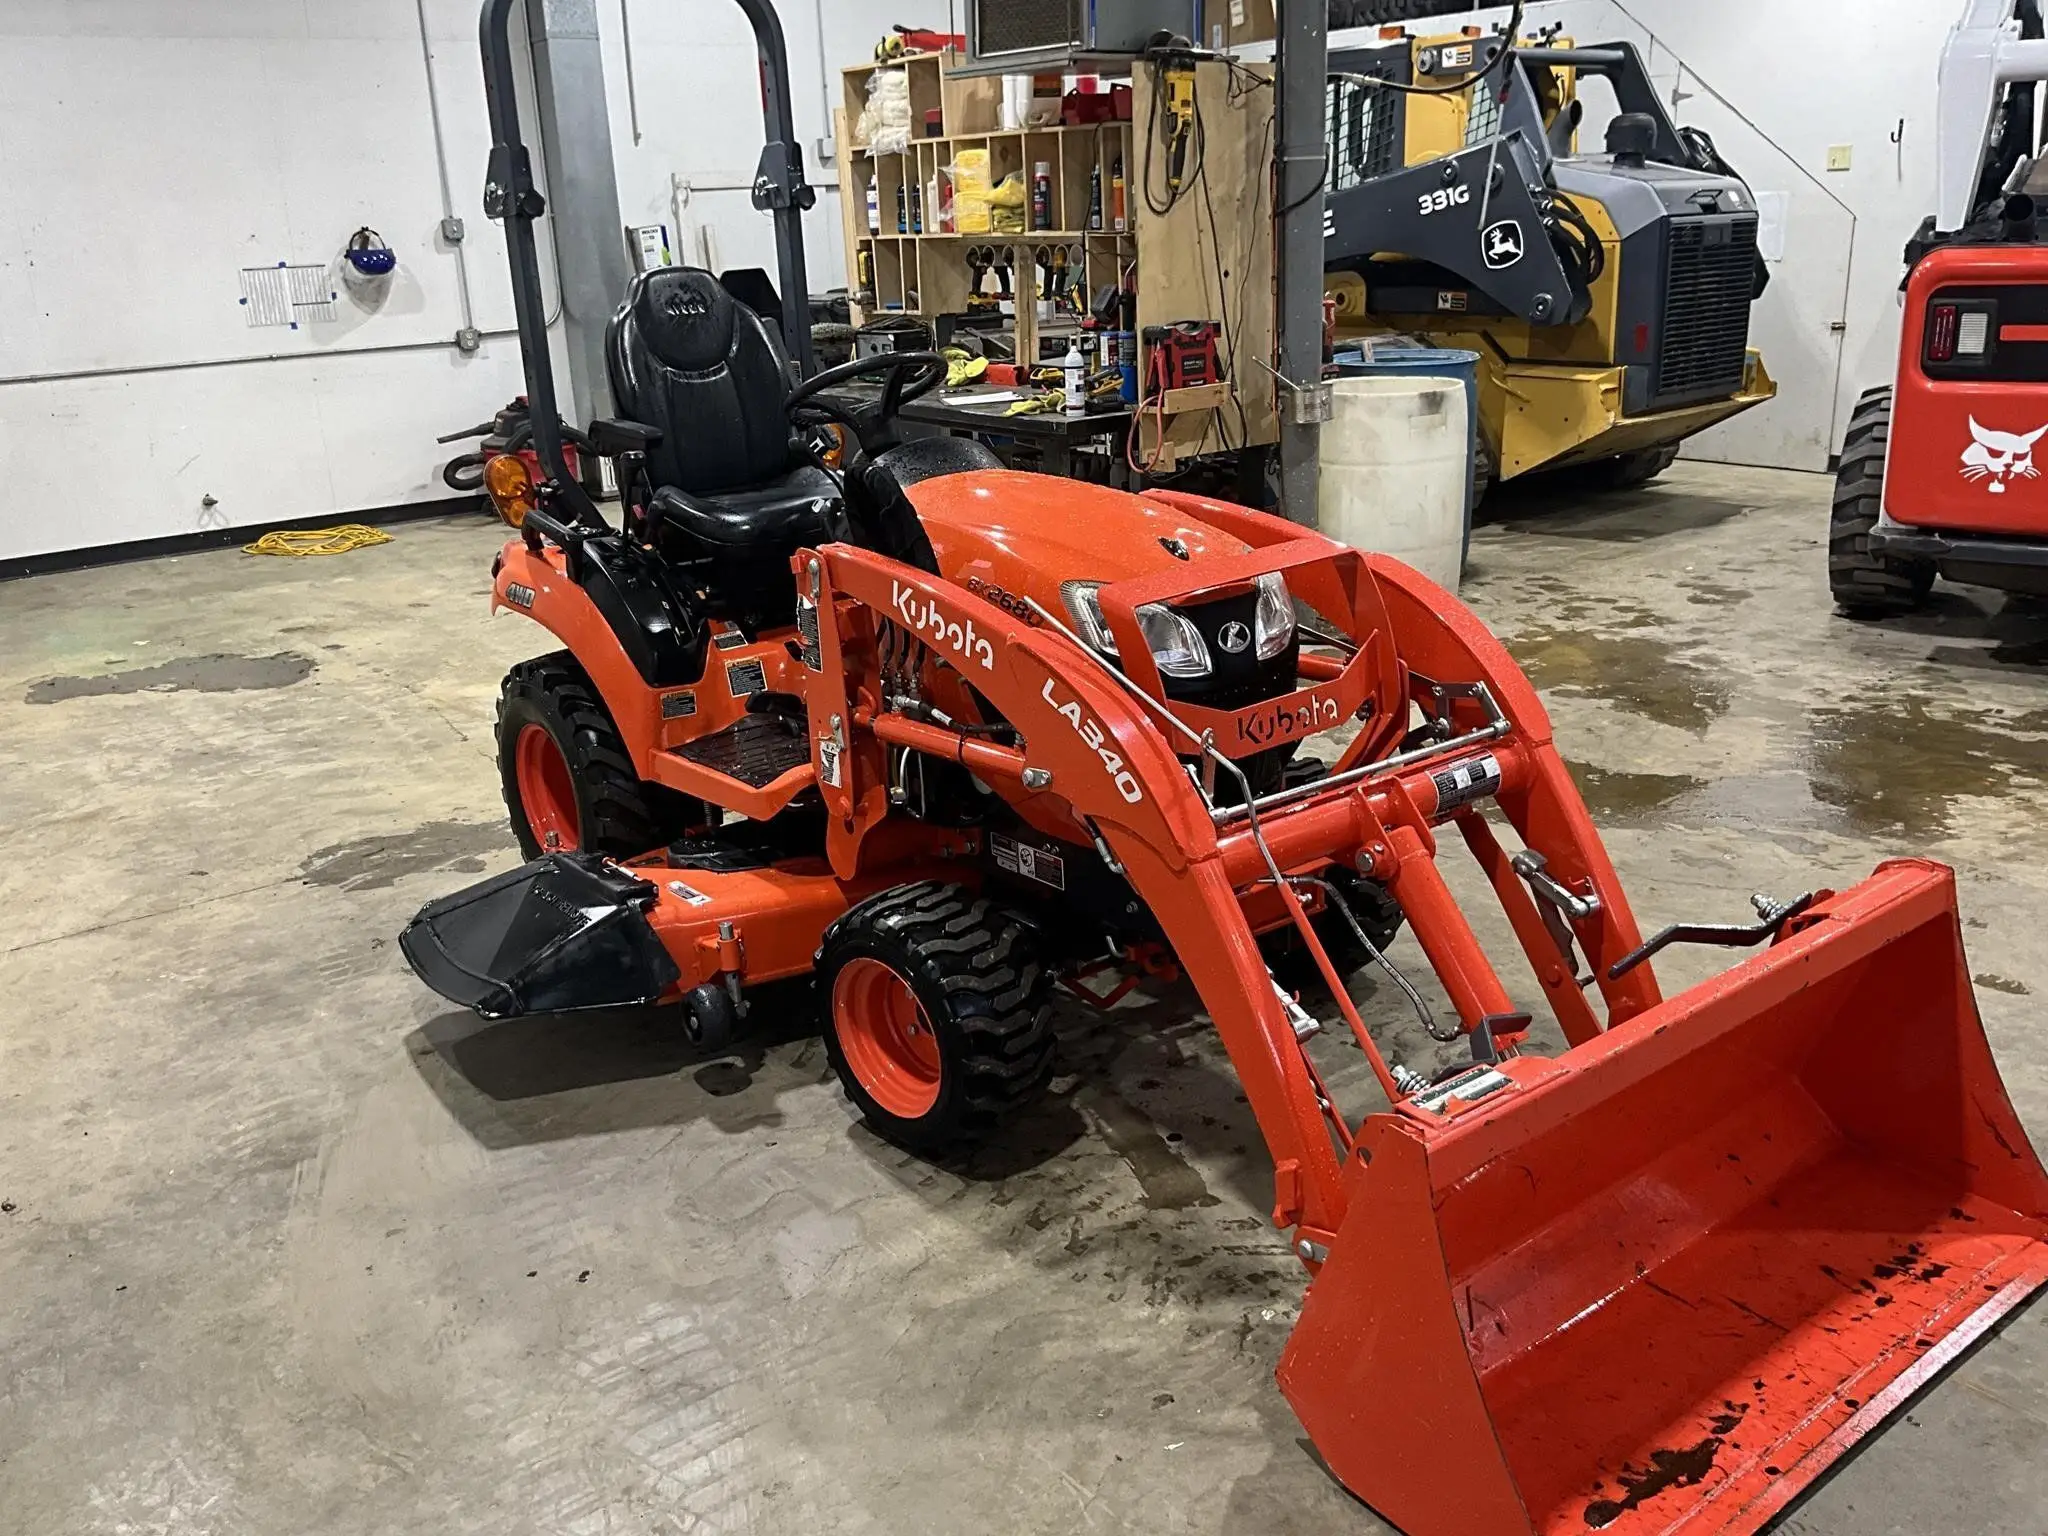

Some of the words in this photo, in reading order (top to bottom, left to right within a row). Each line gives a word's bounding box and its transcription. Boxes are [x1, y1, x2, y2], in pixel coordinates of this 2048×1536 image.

[1418, 184, 1470, 216] 331G
[506, 582, 536, 608] 4WD
[892, 579, 993, 671] Kubota
[1041, 677, 1143, 804] LA340
[1237, 694, 1338, 744] Kubota
